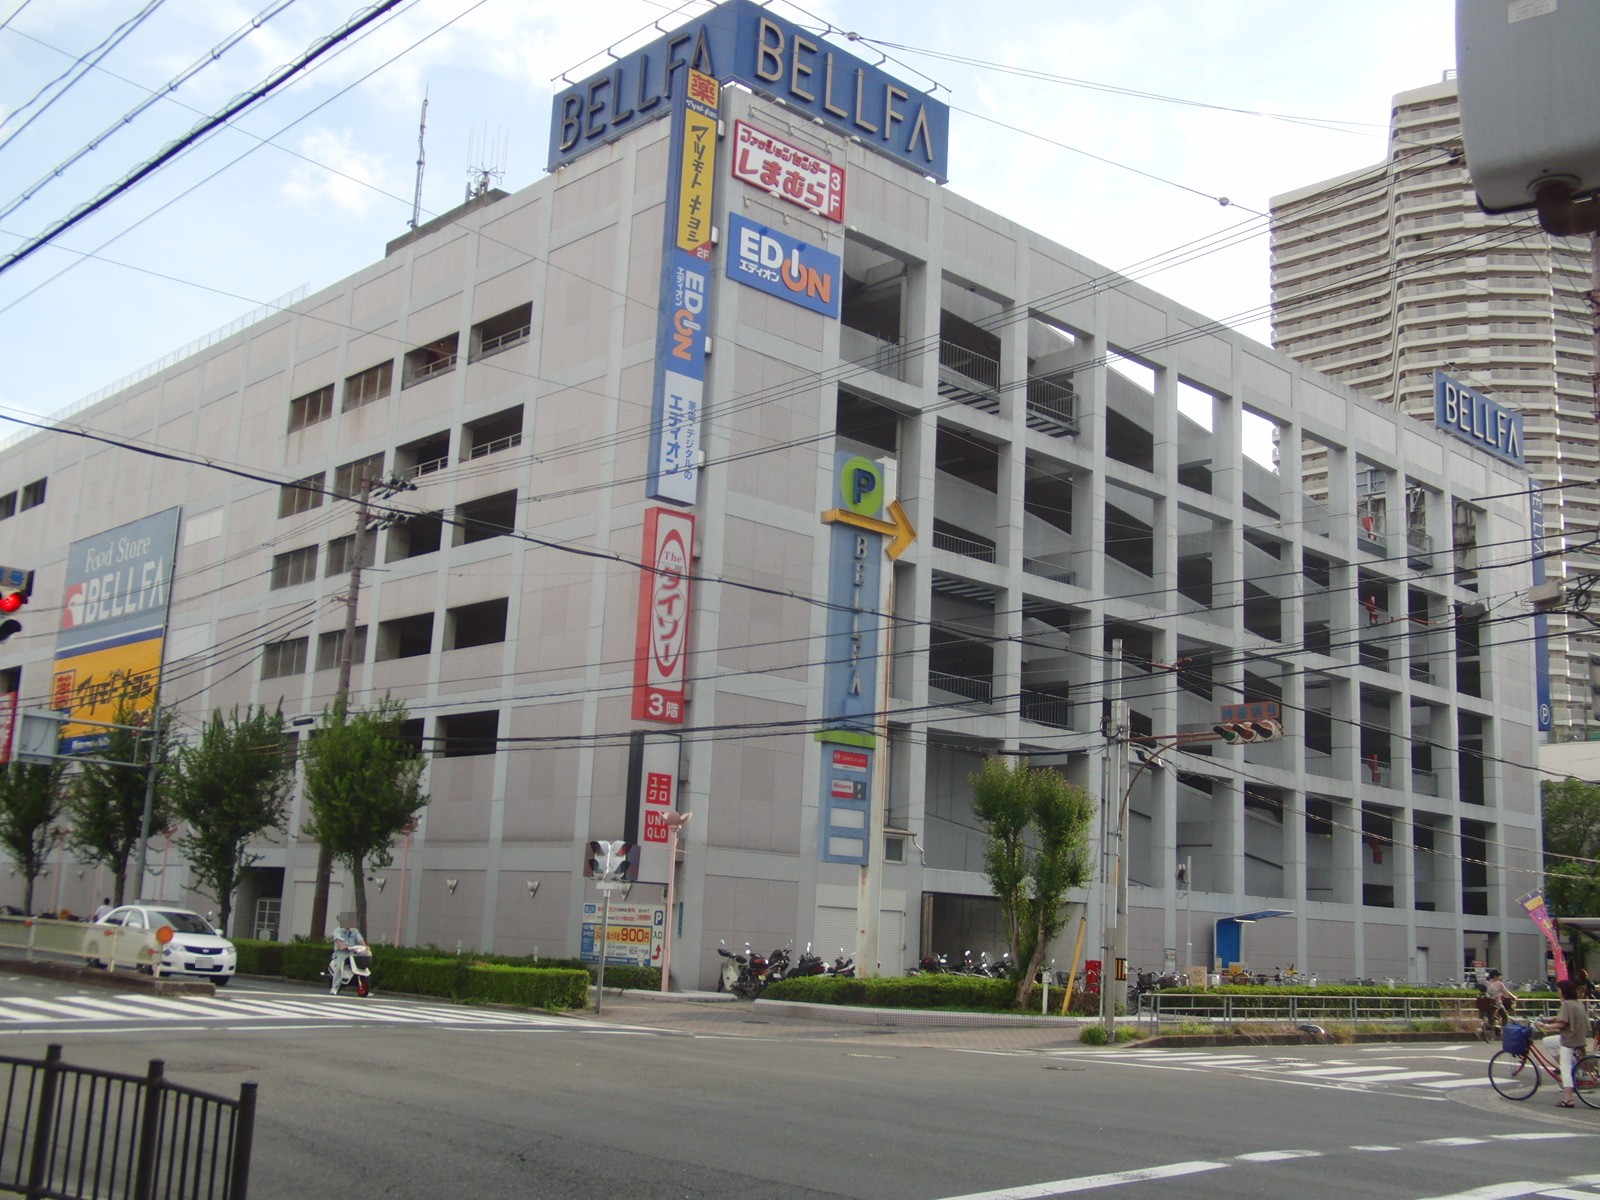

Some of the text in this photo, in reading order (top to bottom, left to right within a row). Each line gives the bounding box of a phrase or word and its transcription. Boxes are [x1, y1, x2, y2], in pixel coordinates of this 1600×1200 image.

[559, 24, 715, 152] BELLFA
[691, 73, 716, 106] 薬
[756, 16, 933, 162] BELLFA
[687, 125, 709, 243] マツモトキヨシ
[738, 148, 824, 208] しまむら
[740, 128, 827, 175] ファッションセンター
[696, 247, 709, 260] 2F
[739, 259, 780, 283] エディオン
[740, 226, 831, 304] EDION
[672, 270, 705, 361] EDION
[665, 394, 684, 475] エディオン
[1444, 381, 1520, 457] BELLFA
[853, 467, 876, 505] P
[1532, 483, 1544, 554] BELLFA
[85, 536, 150, 574] Food Store
[85, 554, 164, 624] BELLFA
[663, 550, 682, 563] The
[657, 565, 682, 663] ダイソー
[648, 693, 679, 719] 3階
